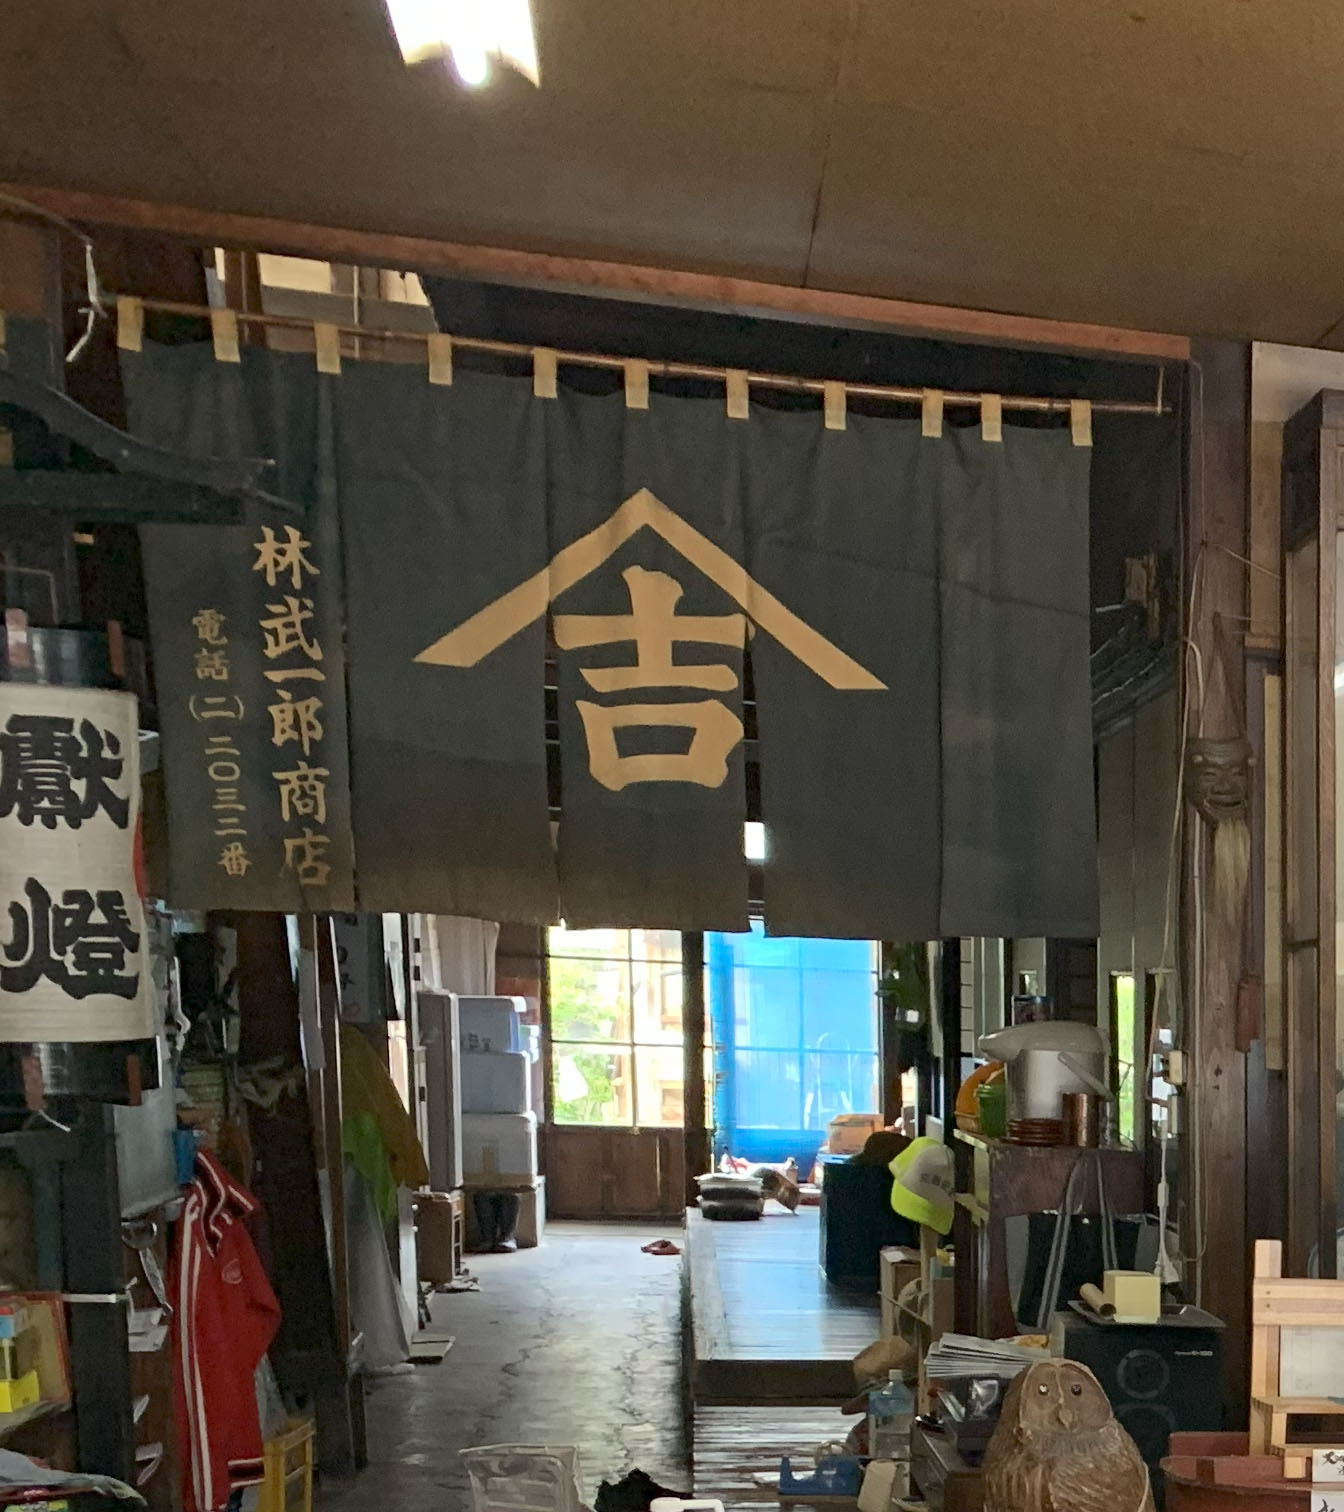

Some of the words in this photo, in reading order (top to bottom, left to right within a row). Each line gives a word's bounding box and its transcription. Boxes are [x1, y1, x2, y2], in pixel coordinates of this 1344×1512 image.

[252, 524, 332, 886] 林武一郎商店
[552, 563, 754, 792] 吉
